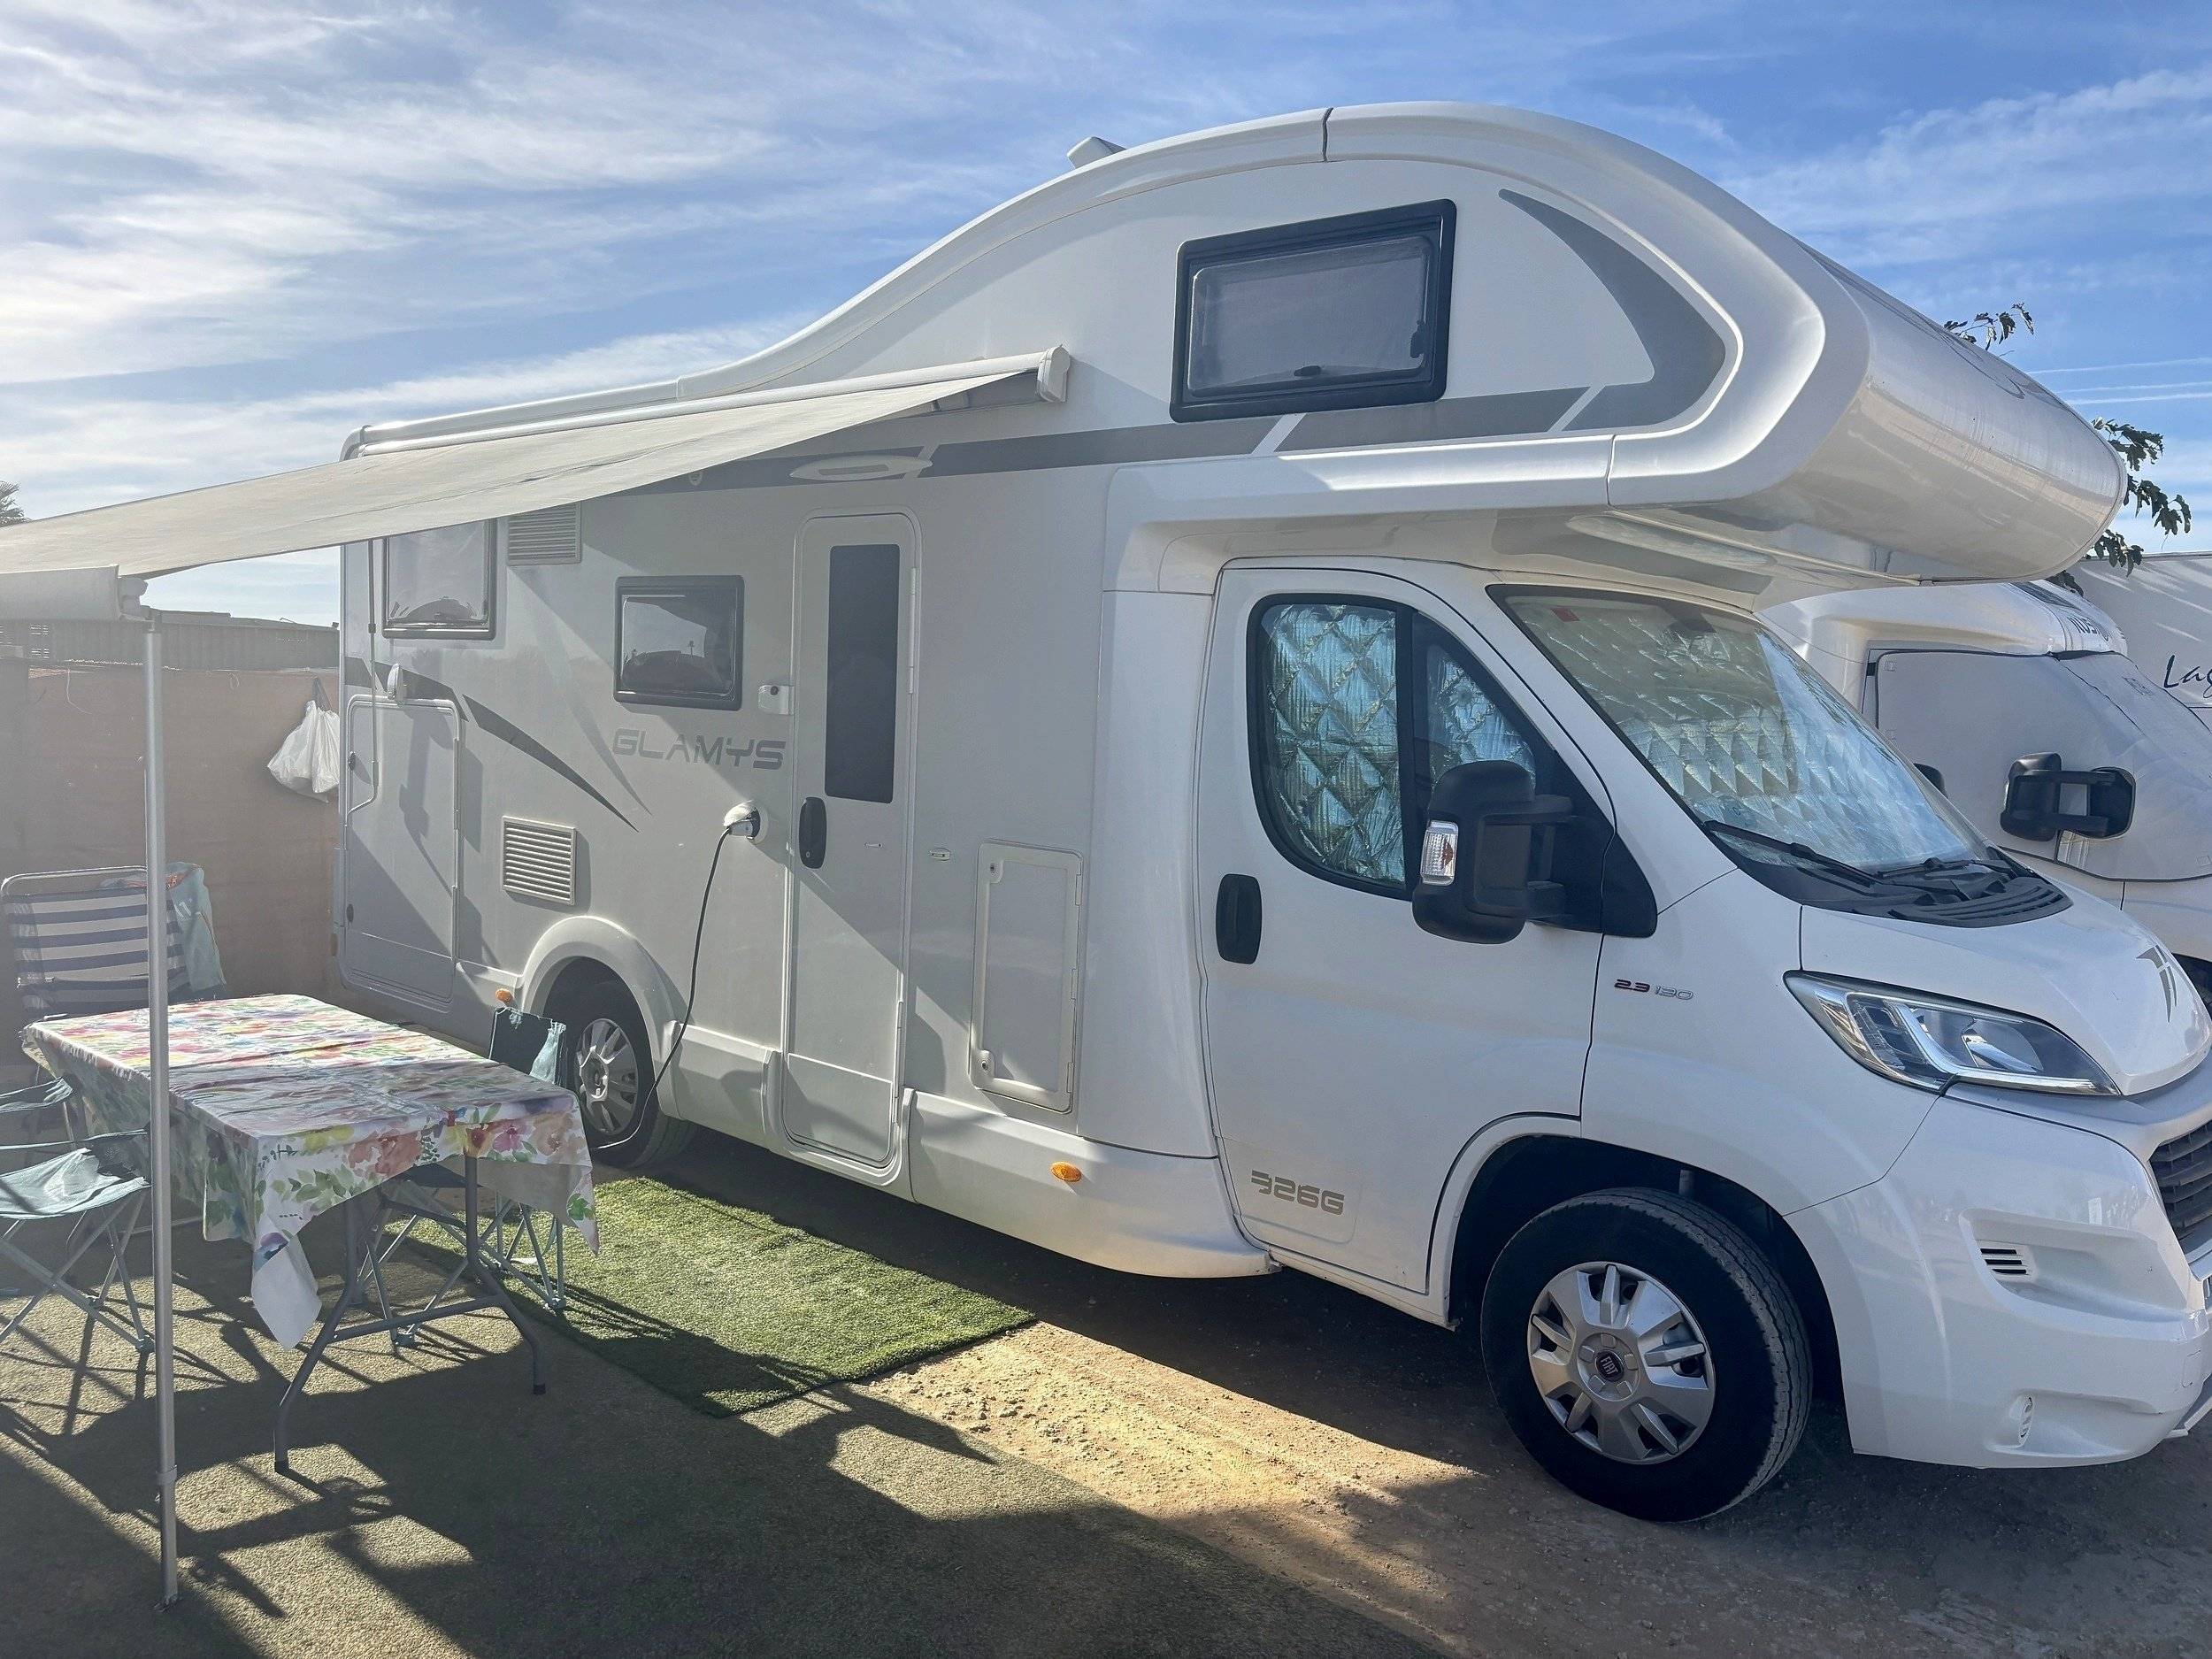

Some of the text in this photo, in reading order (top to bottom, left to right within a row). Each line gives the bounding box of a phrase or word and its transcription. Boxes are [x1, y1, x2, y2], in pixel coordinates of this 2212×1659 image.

[613, 727, 787, 771] GLAMYS
[1655, 985, 1694, 1001] 130
[1250, 1170, 1345, 1216] 326G
[1600, 1356, 1618, 1375] FIAT
